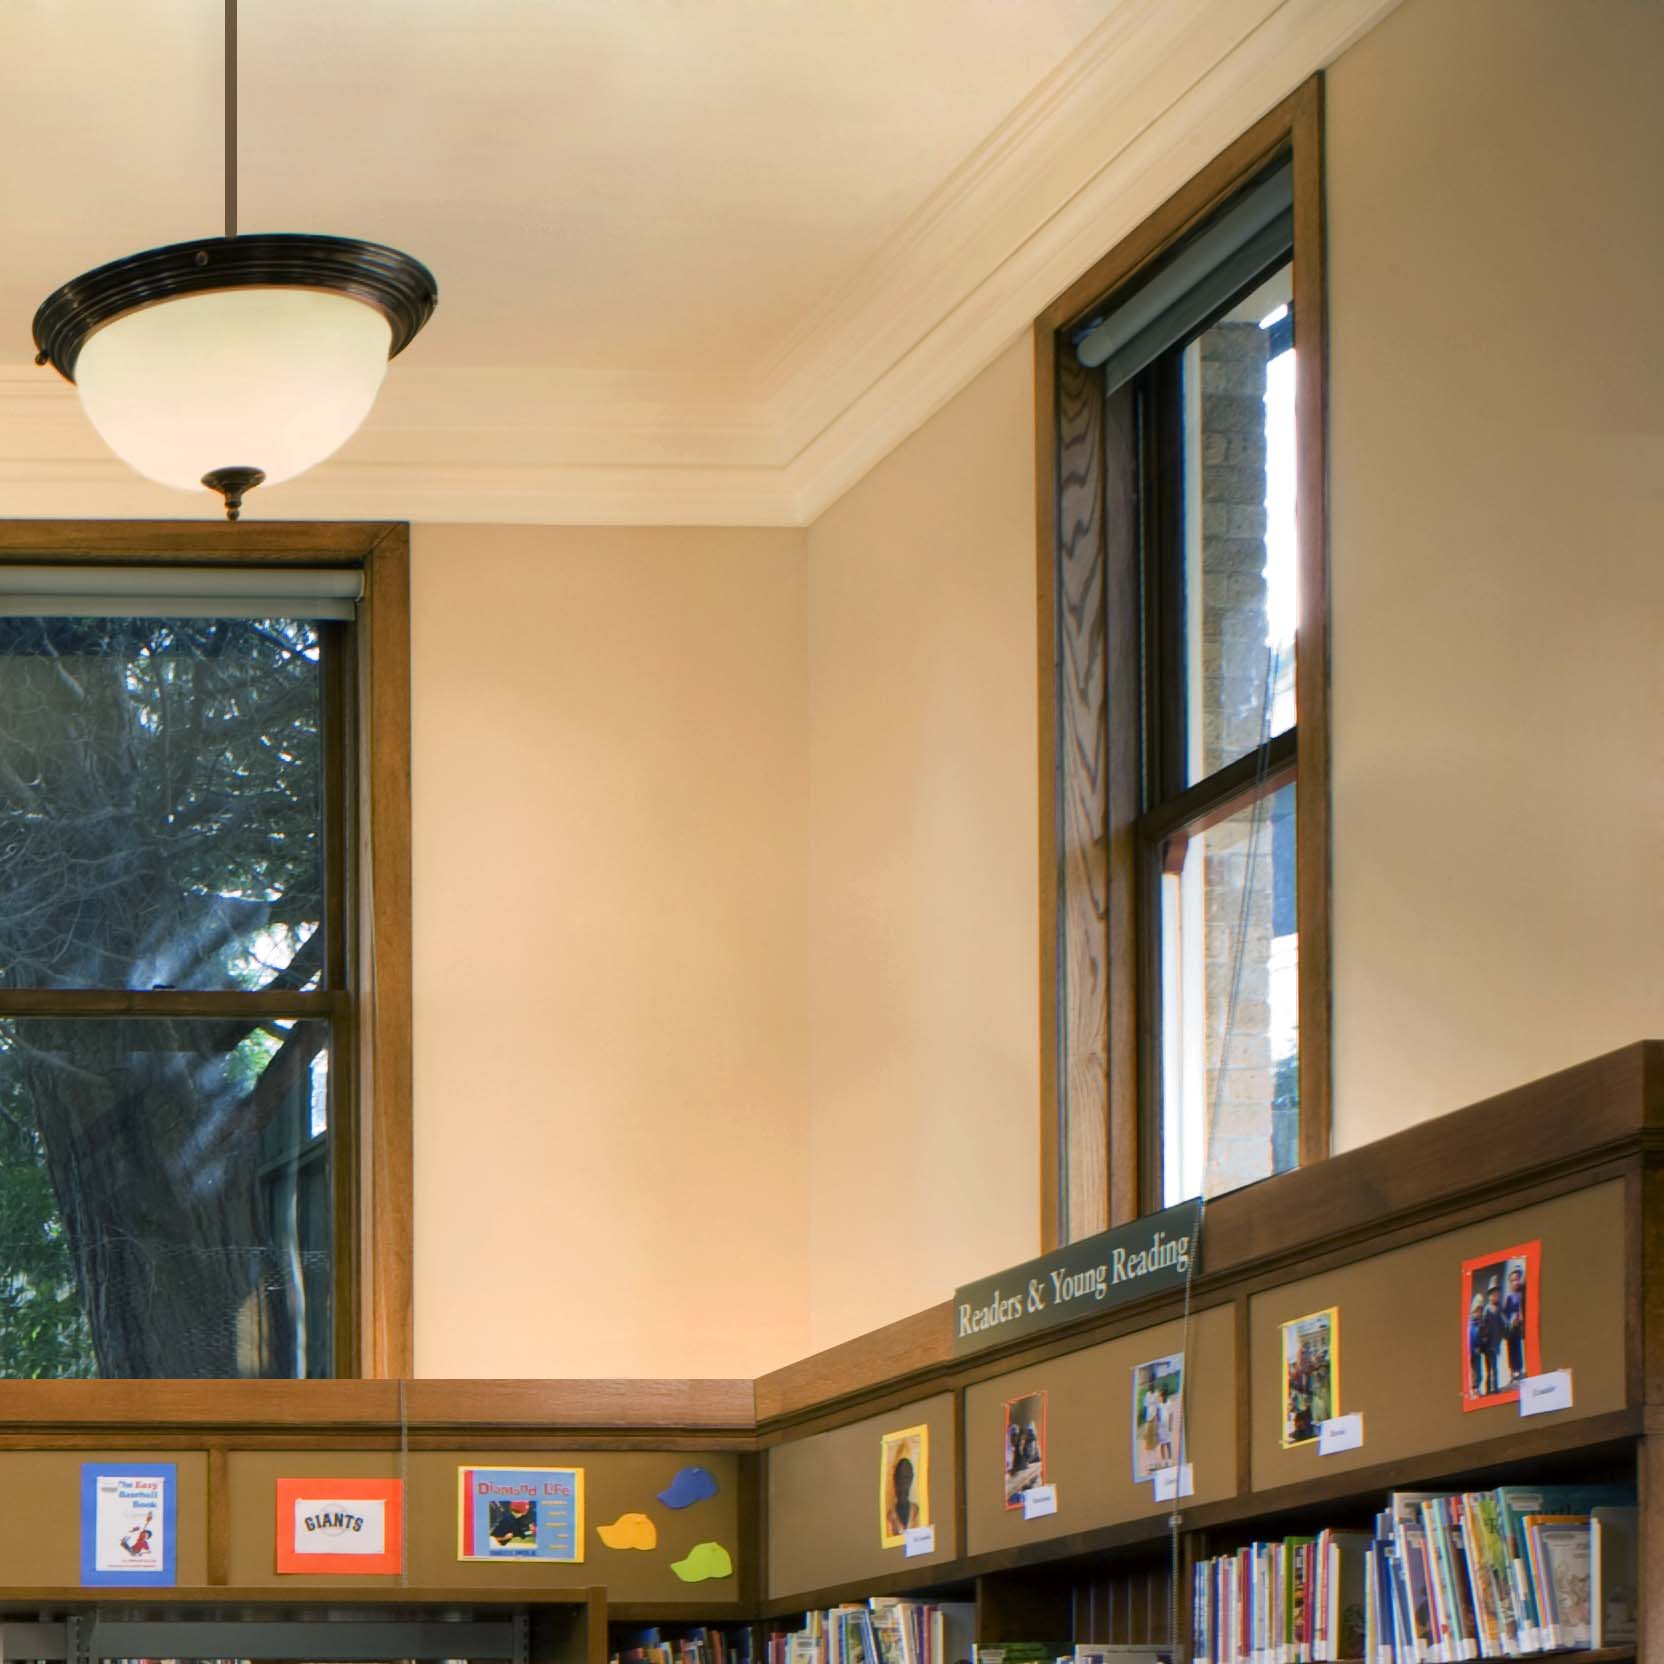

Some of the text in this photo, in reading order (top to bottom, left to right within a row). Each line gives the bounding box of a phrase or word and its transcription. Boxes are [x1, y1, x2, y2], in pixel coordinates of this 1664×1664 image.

[957, 1231, 1190, 1338] Readers & Young Reading
[118, 1491, 158, 1499] Baseball
[477, 1481, 537, 1497] Diamond
[132, 1500, 158, 1508] Book
[304, 1512, 364, 1532] GIANTS
